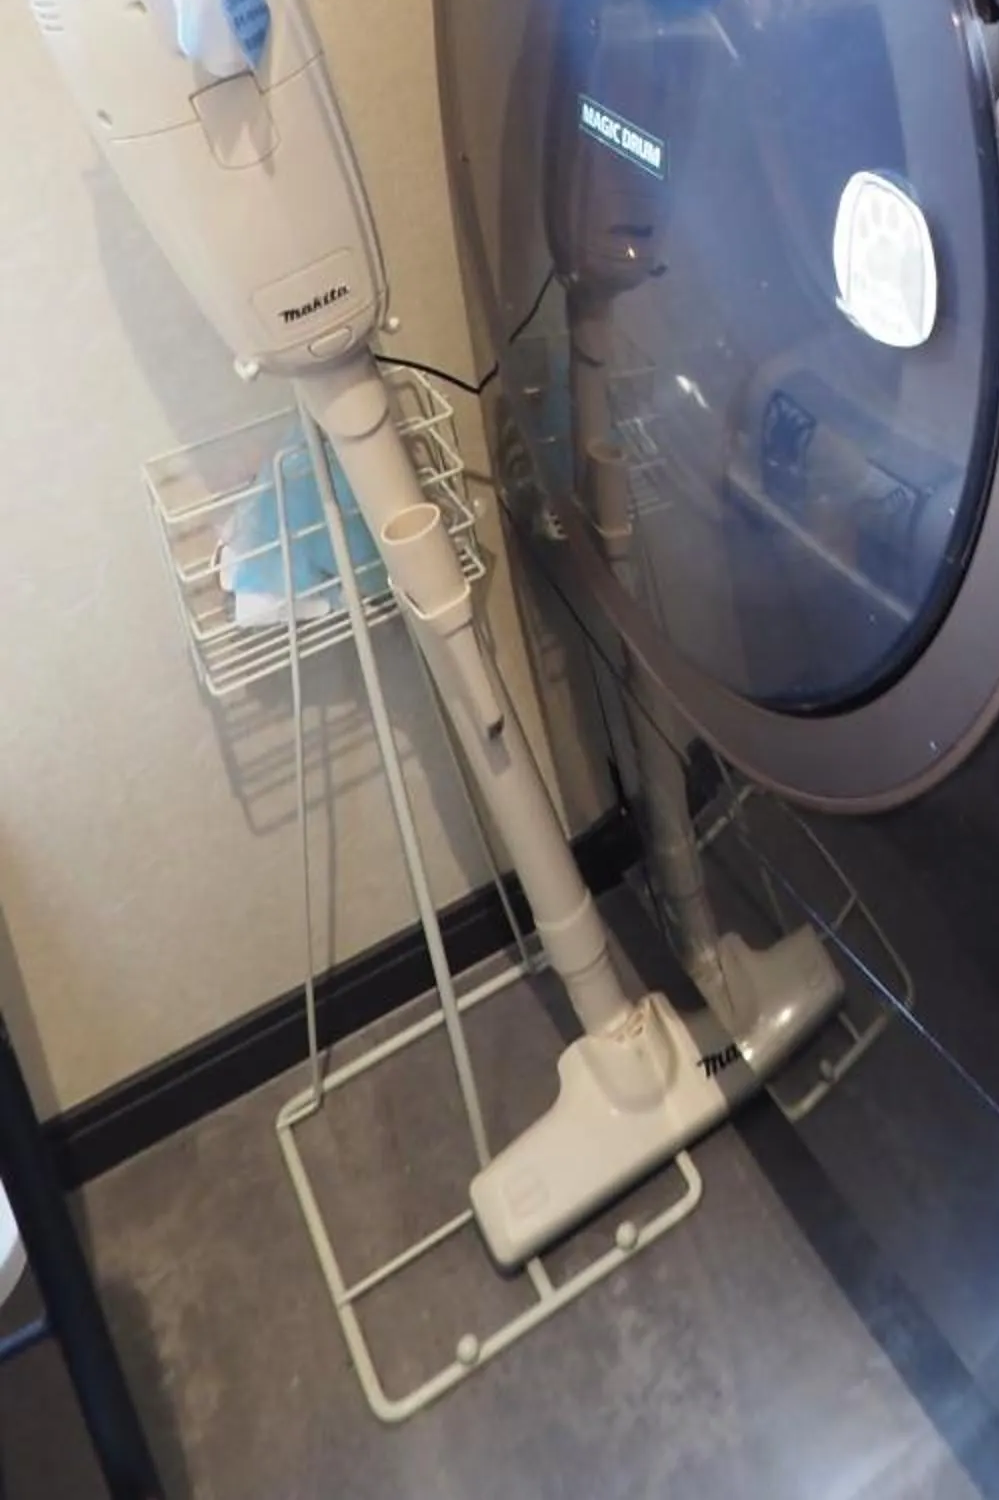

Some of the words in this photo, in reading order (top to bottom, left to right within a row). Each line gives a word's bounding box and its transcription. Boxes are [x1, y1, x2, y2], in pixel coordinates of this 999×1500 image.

[582, 103, 621, 145] MAGIC
[621, 127, 661, 169] DRUM
[278, 284, 351, 324] makita
